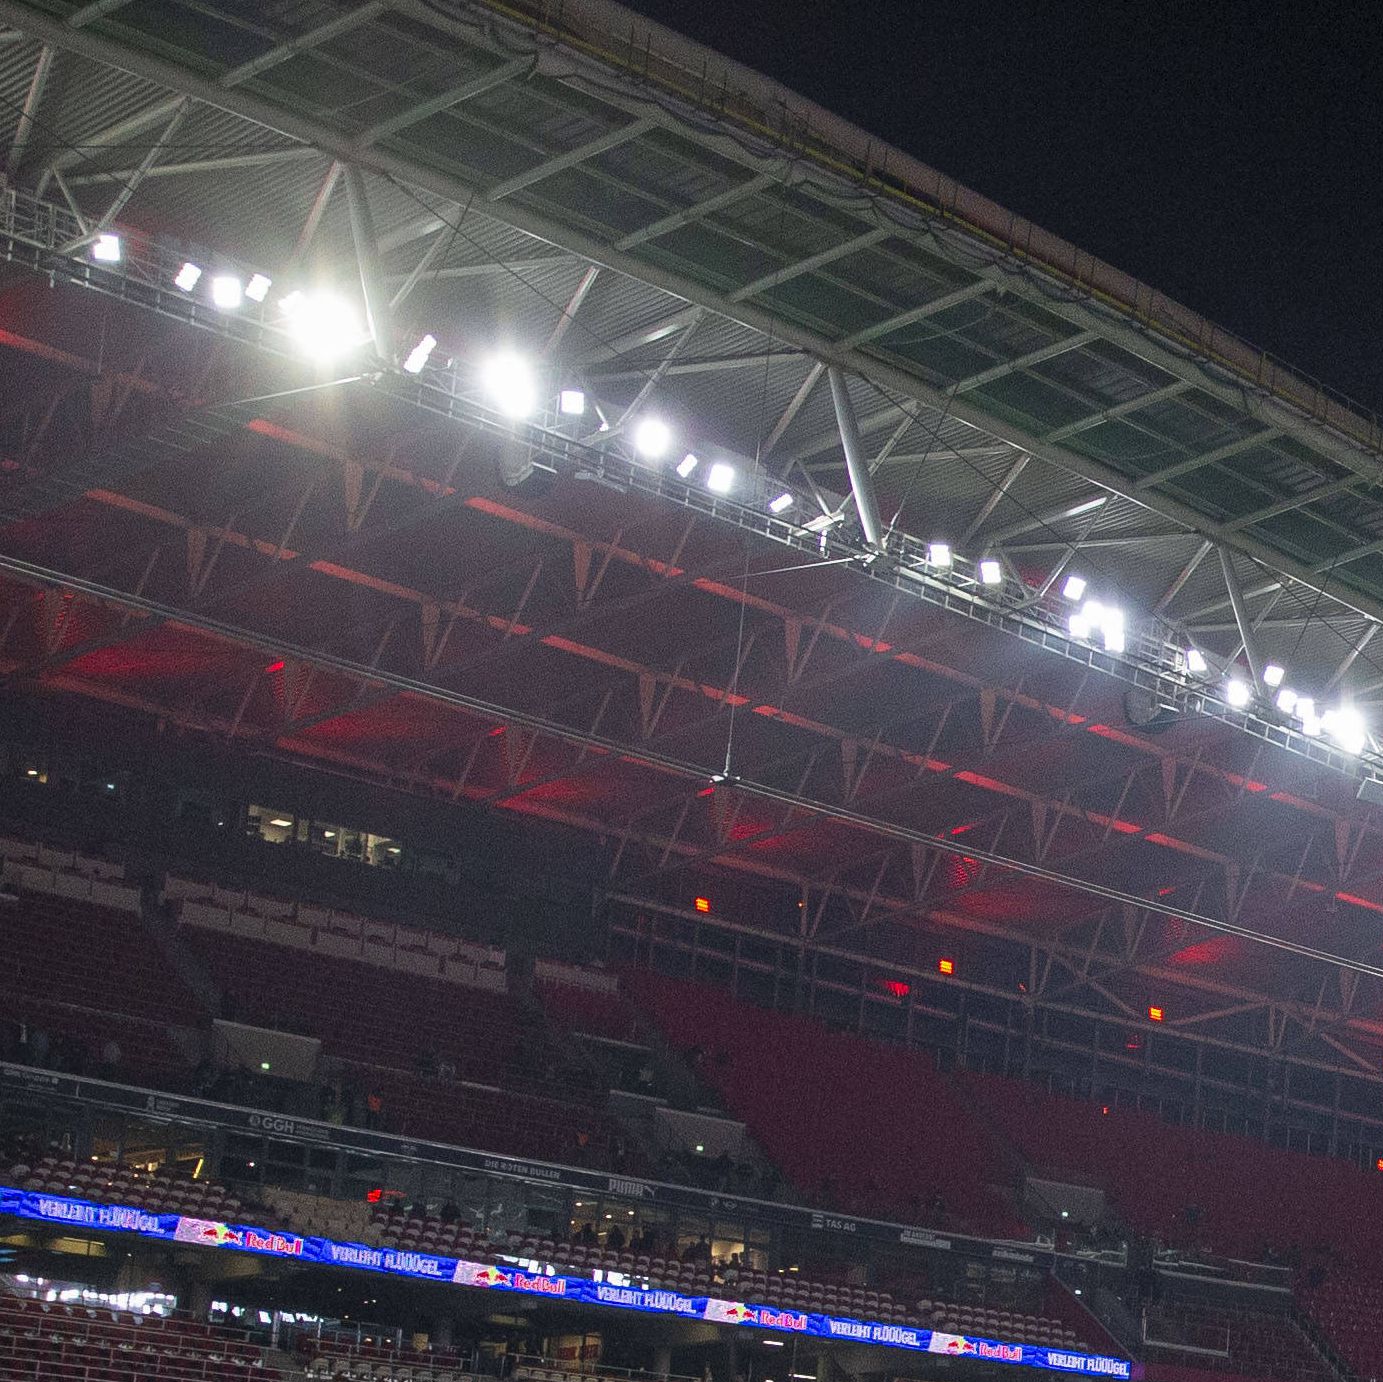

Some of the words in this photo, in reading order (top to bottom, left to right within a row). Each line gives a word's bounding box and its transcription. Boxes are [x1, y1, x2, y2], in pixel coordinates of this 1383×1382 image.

[262, 1116, 294, 1134] GGH
[826, 1219, 842, 1229] TAS
[843, 1223, 856, 1232] AG
[514, 1273, 541, 1292] Red
[760, 1310, 783, 1328] Red
[979, 1343, 1000, 1359] Red
[1001, 1345, 1022, 1361] Bull
